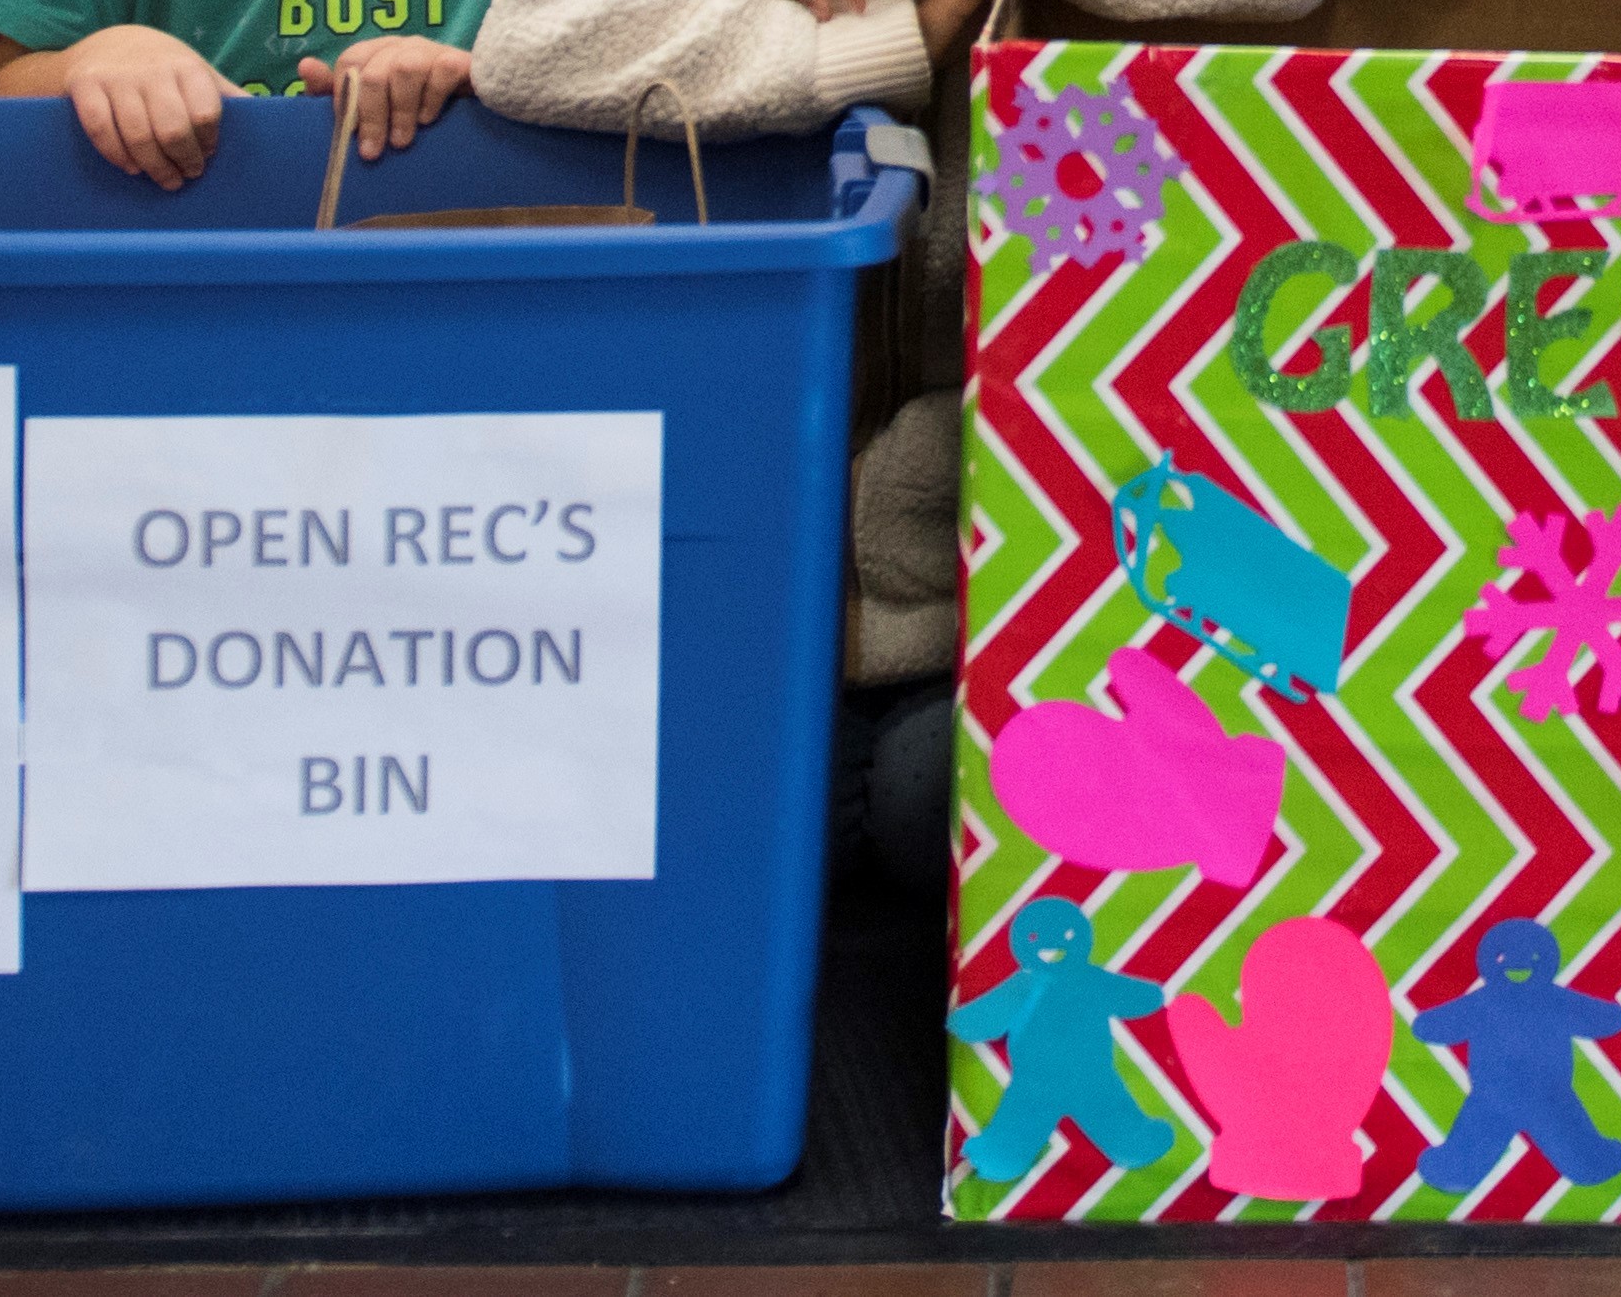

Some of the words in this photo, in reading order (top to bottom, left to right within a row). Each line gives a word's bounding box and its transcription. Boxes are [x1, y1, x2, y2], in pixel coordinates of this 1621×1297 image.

[133, 506, 352, 569] OPEN
[383, 498, 597, 567] REC’S
[145, 627, 583, 691] DONATION
[299, 753, 430, 816] BIN
